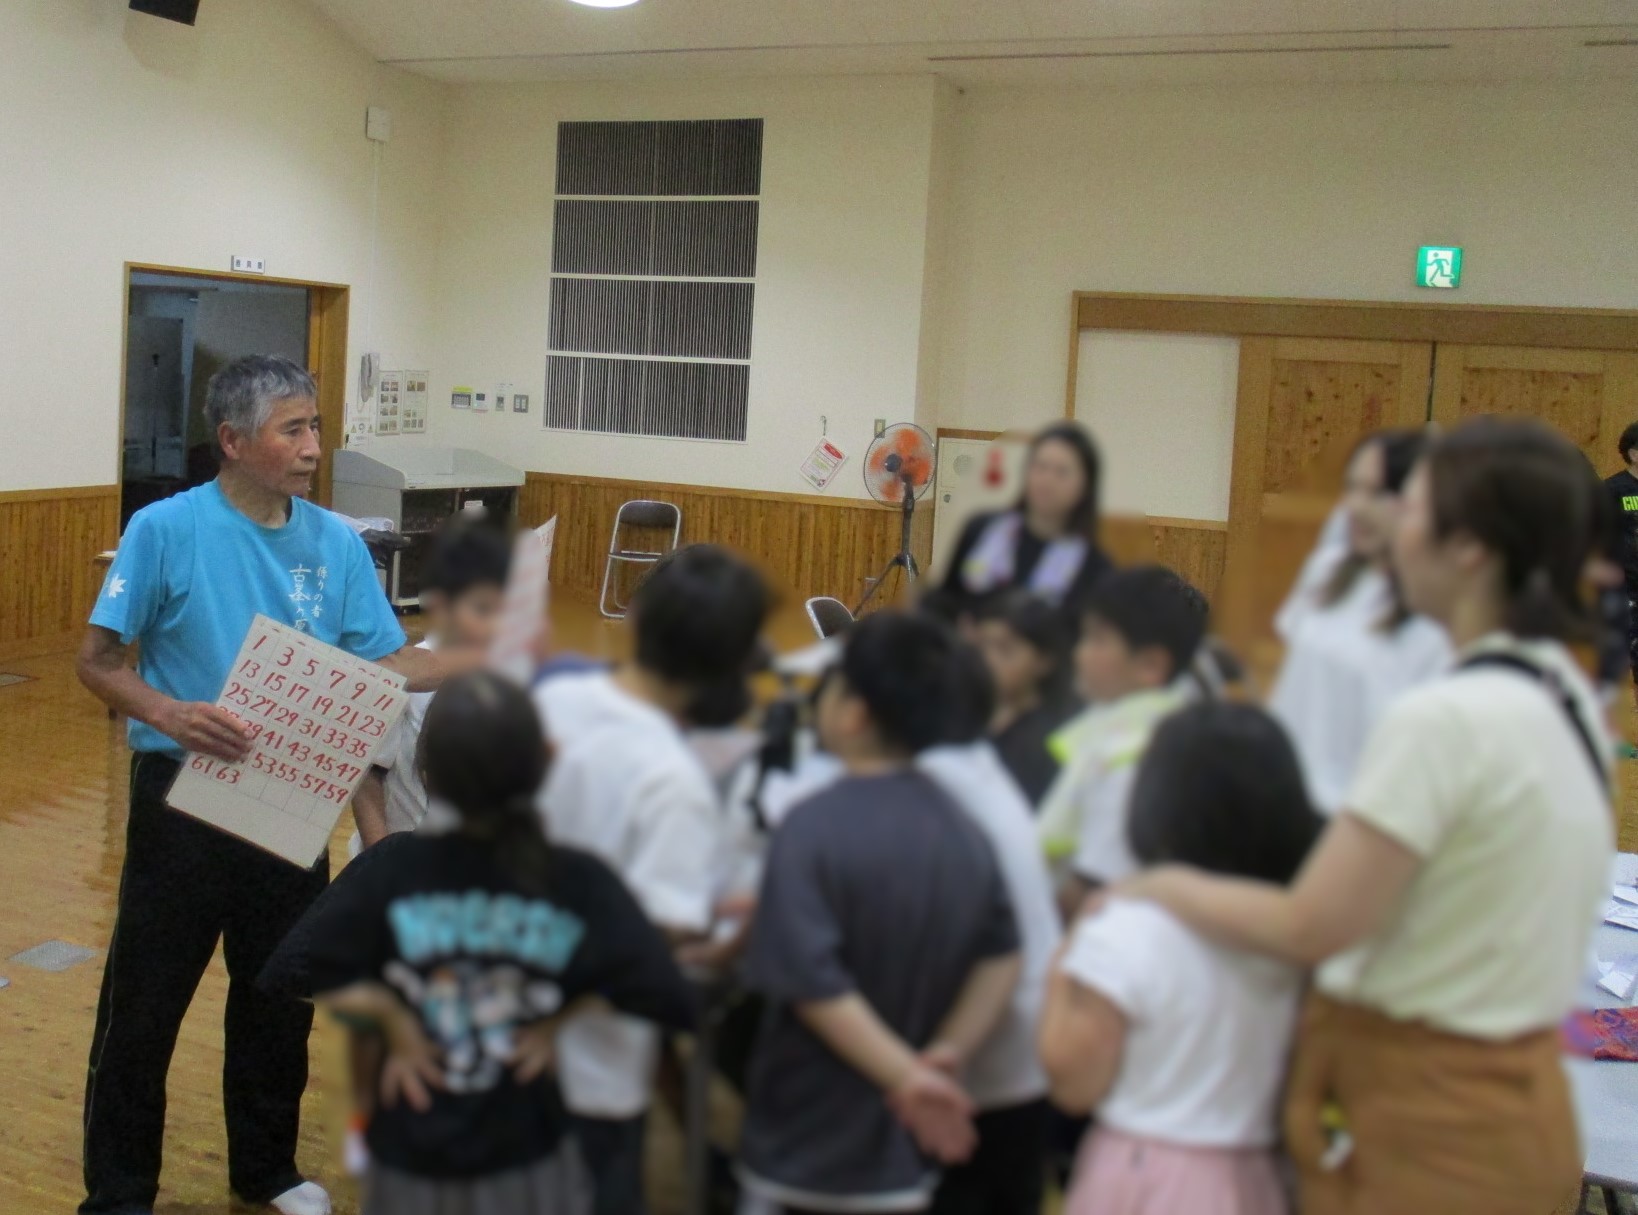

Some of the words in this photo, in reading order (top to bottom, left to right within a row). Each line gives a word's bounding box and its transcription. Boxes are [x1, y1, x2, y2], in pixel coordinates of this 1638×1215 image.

[239, 660, 260, 678] 13
[264, 672, 286, 692] 15
[287, 683, 309, 703] 17
[312, 695, 333, 715] 19
[335, 705, 358, 727] 21
[358, 716, 383, 737] 23
[253, 635, 267, 650] 1
[277, 647, 294, 666] 3
[302, 659, 320, 676] 5
[329, 670, 345, 689] 7
[351, 682, 367, 700] 9
[374, 694, 393, 710] 11
[225, 682, 252, 705] 25
[250, 695, 277, 717] 27
[275, 707, 299, 727] 29
[299, 719, 321, 738] 31
[322, 729, 347, 750] 33
[346, 739, 371, 758] 35
[192, 756, 211, 774] 61
[216, 767, 241, 784] 63
[252, 752, 274, 774] 53
[275, 764, 297, 783] 55
[300, 773, 322, 794] 57
[323, 782, 348, 803] 59
[264, 731, 283, 750] 41
[288, 742, 311, 762] 43
[313, 754, 333, 772] 45
[336, 762, 361, 783] 47
